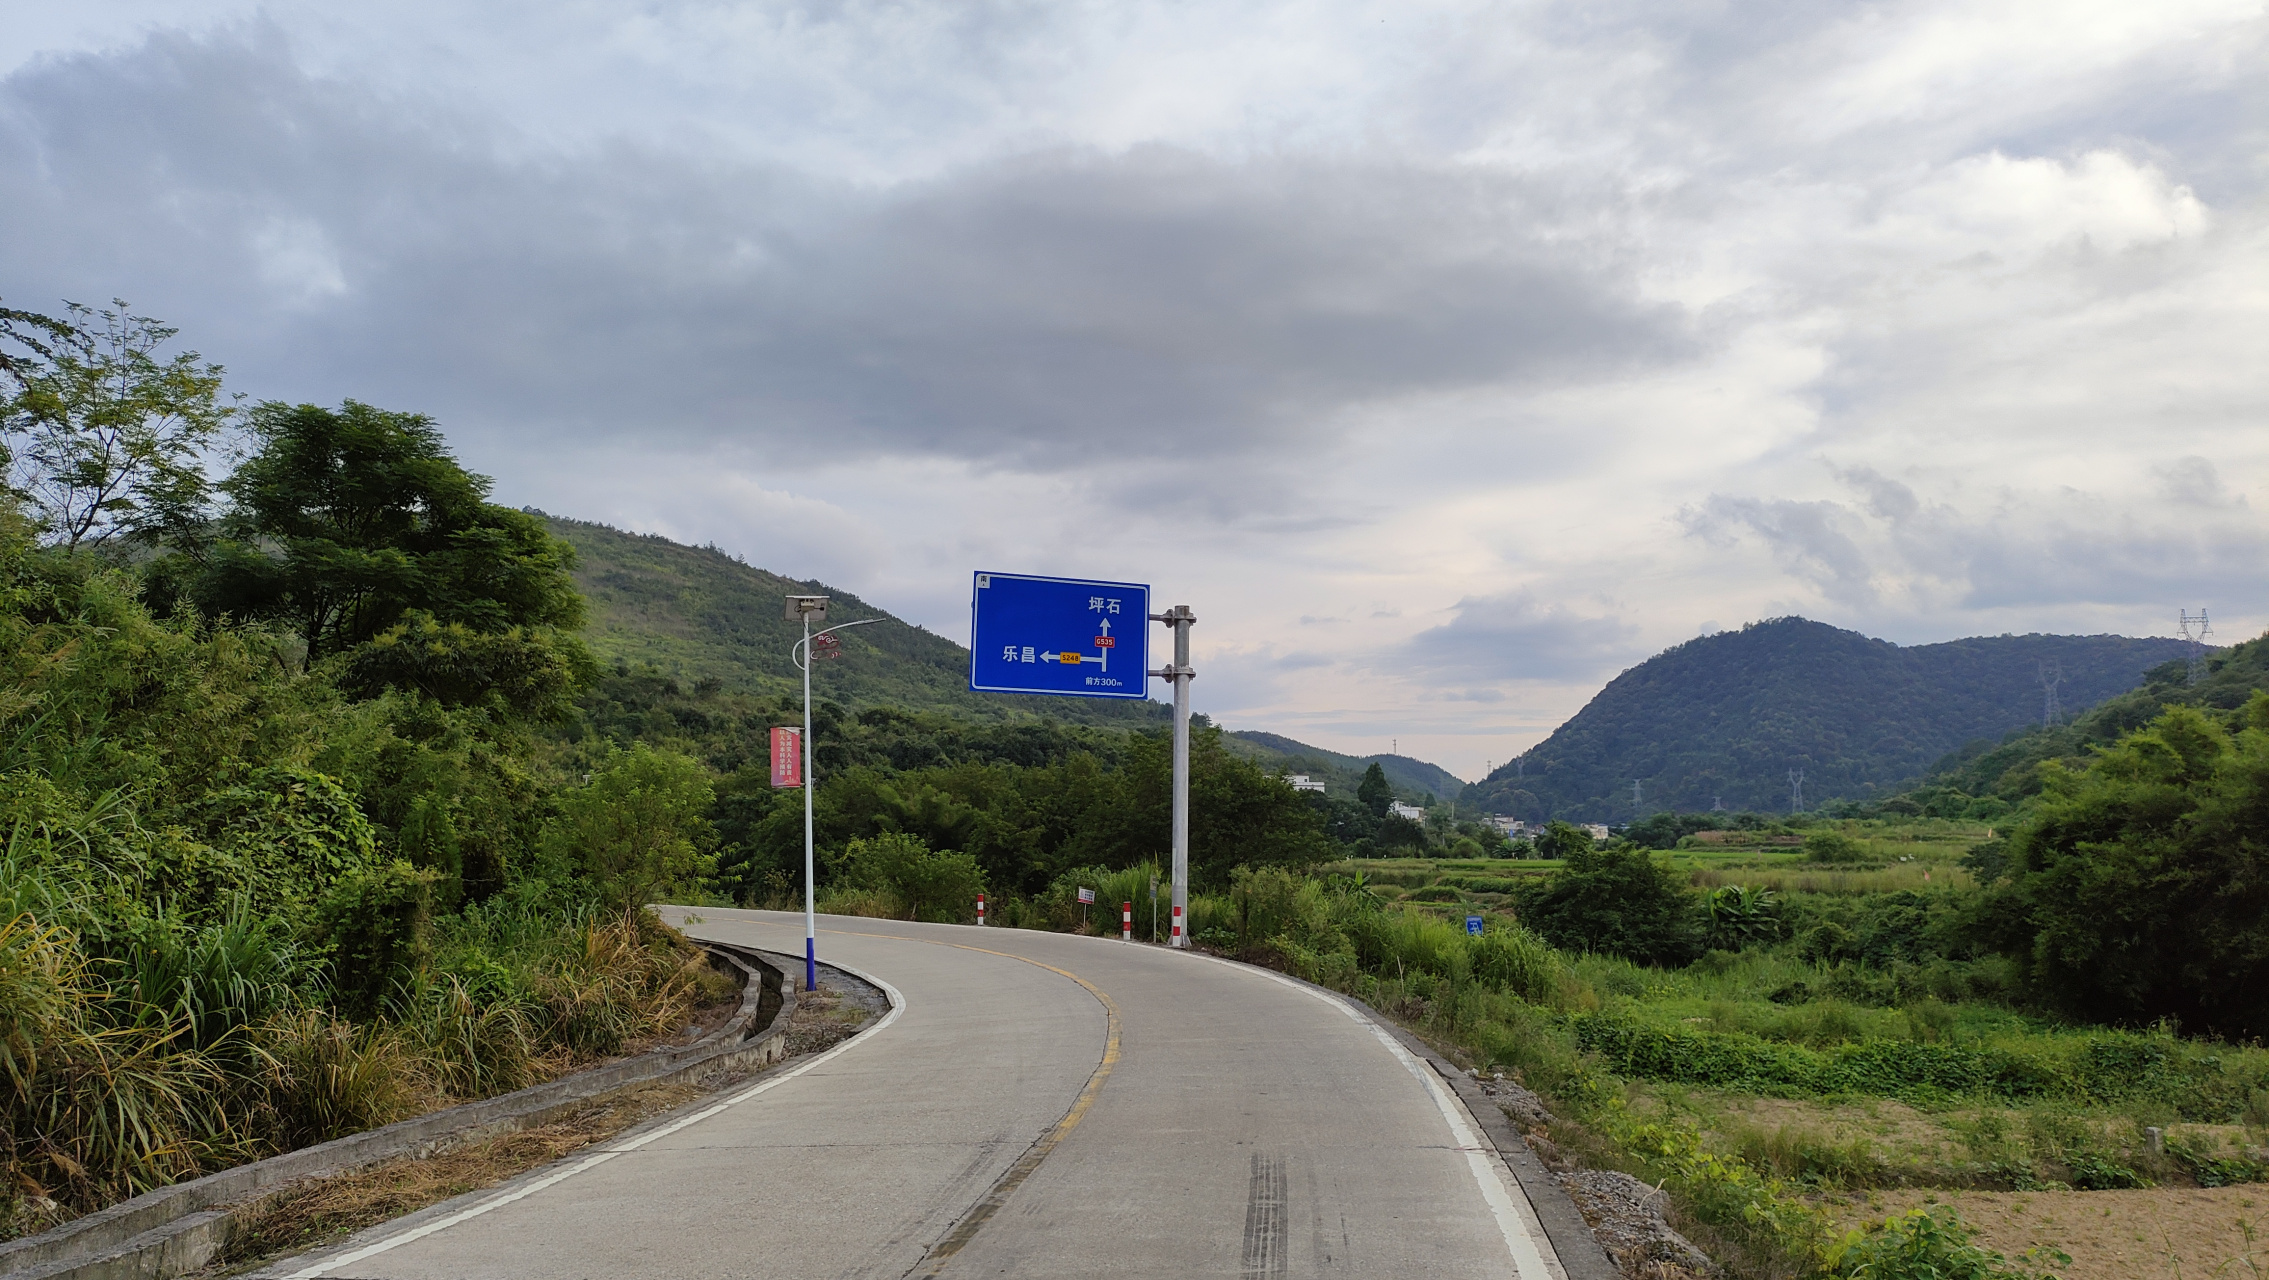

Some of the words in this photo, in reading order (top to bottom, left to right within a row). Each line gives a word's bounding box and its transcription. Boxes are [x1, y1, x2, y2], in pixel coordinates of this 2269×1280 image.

[1088, 596, 1122, 614] 坪石
[1096, 638, 1113, 646] G535
[1002, 645, 1035, 663] 乐昌
[1062, 654, 1079, 662] S248
[1085, 676, 1123, 687] 前方300m
